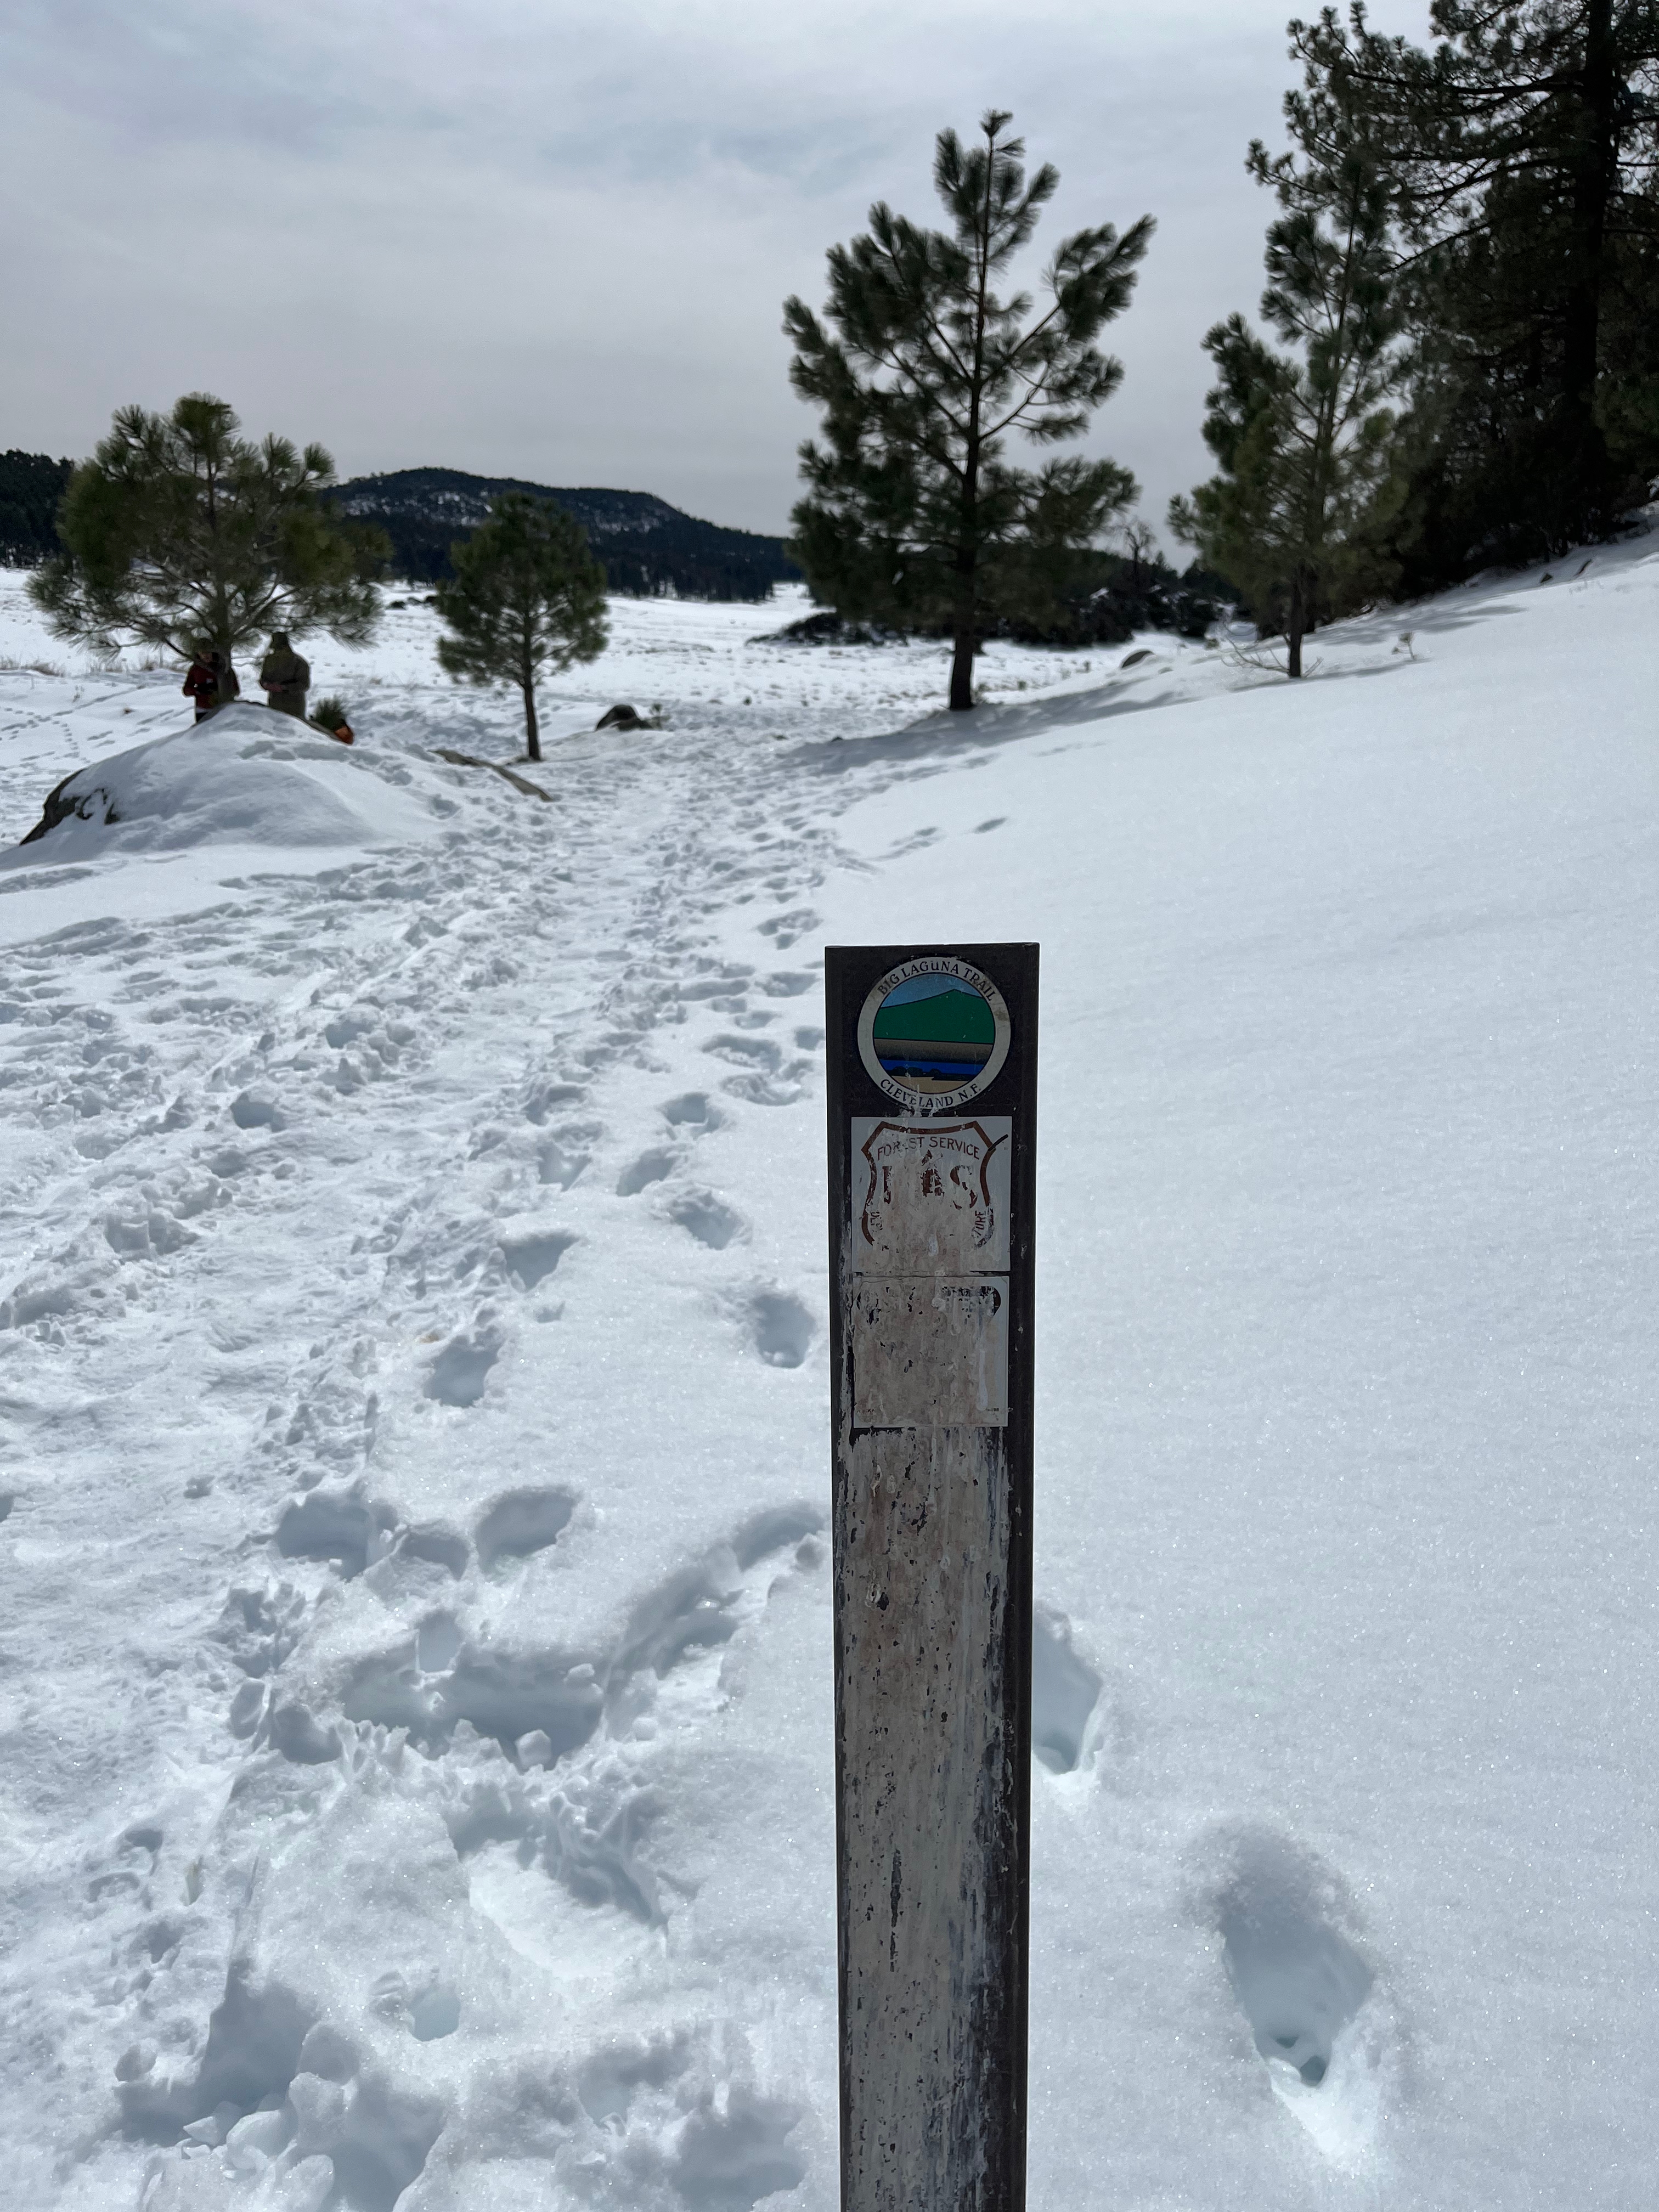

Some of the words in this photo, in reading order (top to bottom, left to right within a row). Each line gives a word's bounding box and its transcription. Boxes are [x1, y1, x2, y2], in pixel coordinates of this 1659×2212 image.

[878, 974, 900, 996] BIG
[901, 961, 960, 977] LAGUNA
[964, 968, 996, 1001] TRAIL
[880, 1079, 953, 1108] CLEVELAND
[958, 1084, 981, 1102] N.F.
[877, 1137, 925, 1161] FORST
[929, 1137, 980, 1160] SERVICE
